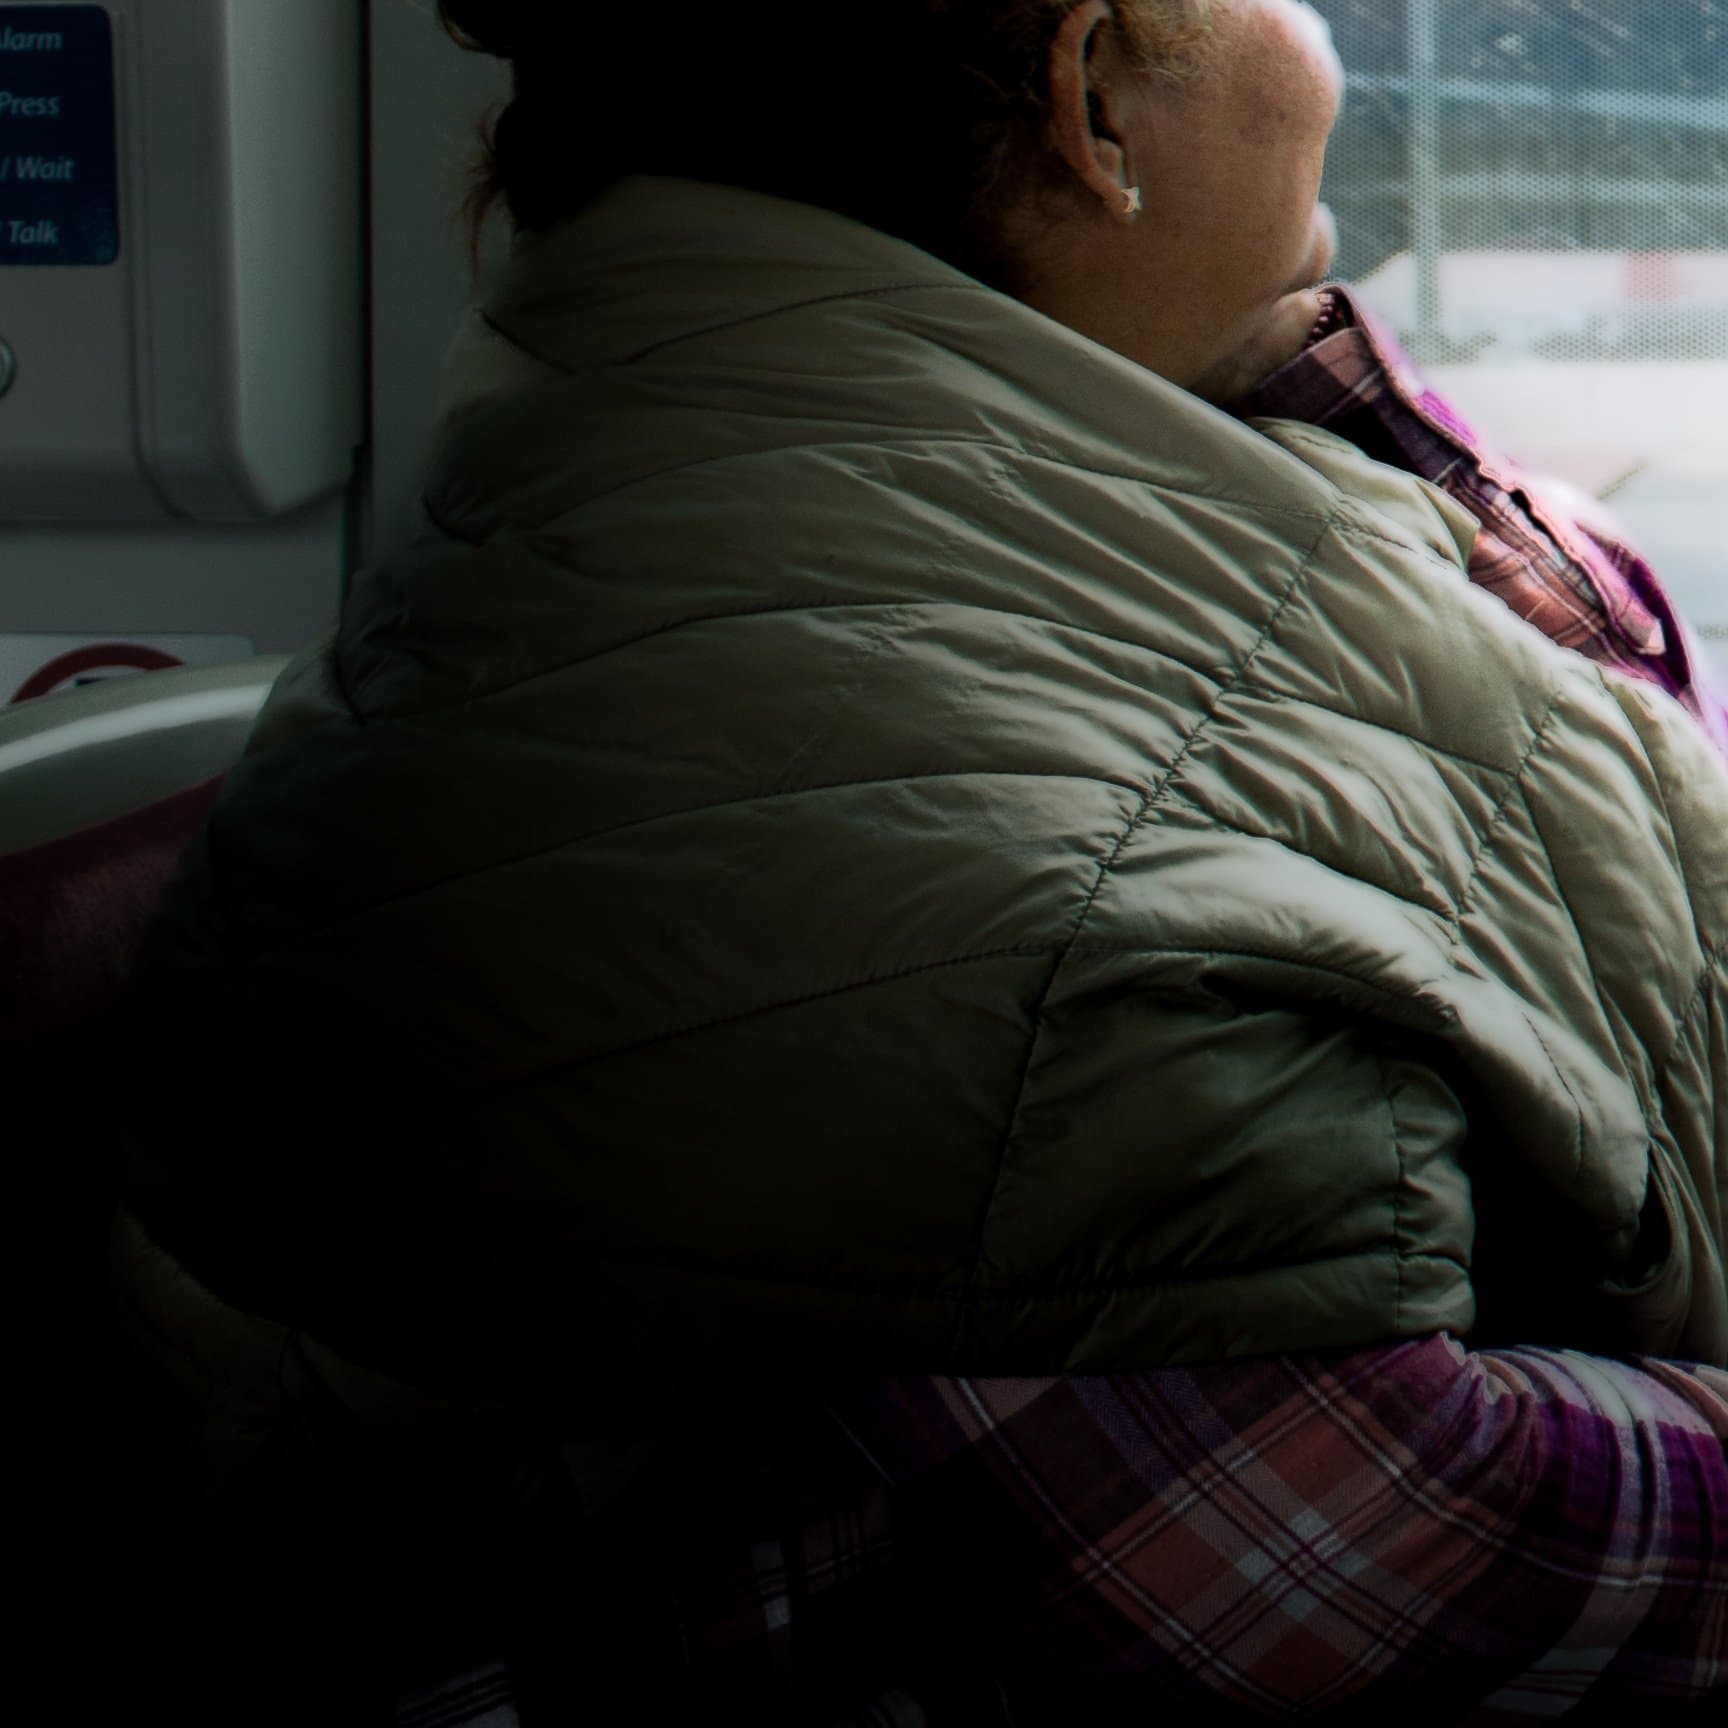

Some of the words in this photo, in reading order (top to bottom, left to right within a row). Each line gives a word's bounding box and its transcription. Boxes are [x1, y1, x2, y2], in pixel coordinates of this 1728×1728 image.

[0, 91, 60, 116] Press
[15, 156, 75, 180] Wait
[8, 220, 58, 244] Talk
